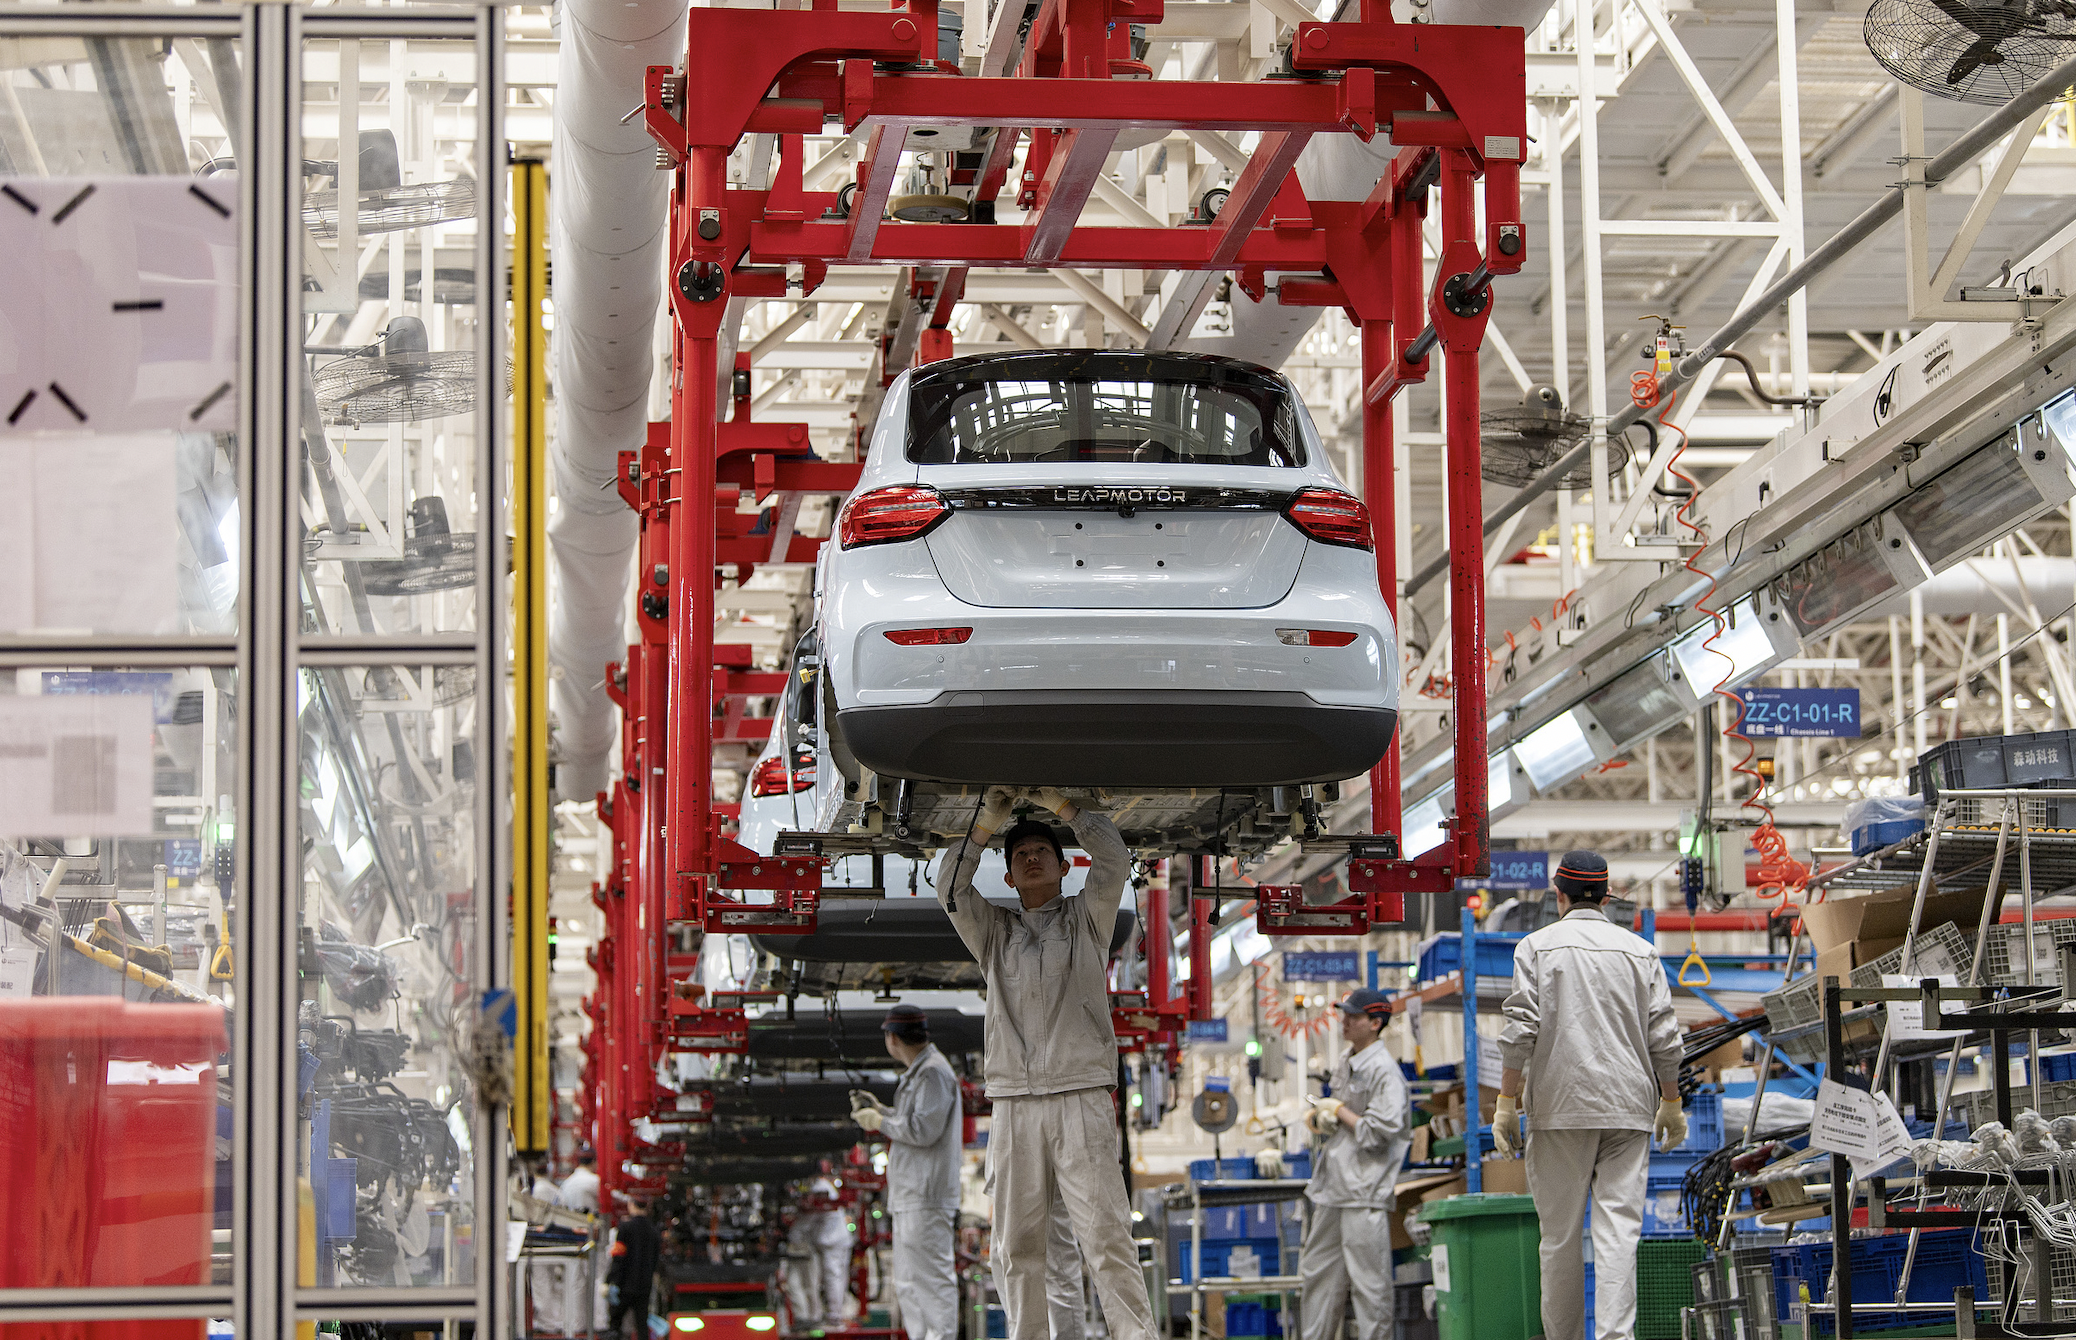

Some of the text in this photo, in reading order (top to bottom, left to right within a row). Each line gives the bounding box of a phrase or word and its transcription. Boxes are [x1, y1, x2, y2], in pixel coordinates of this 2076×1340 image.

[1054, 489, 1186, 502] LEAPMOTOR
[1745, 702, 1853, 723] ZZ-C1-01-R
[172, 849, 201, 866] ZZ-
